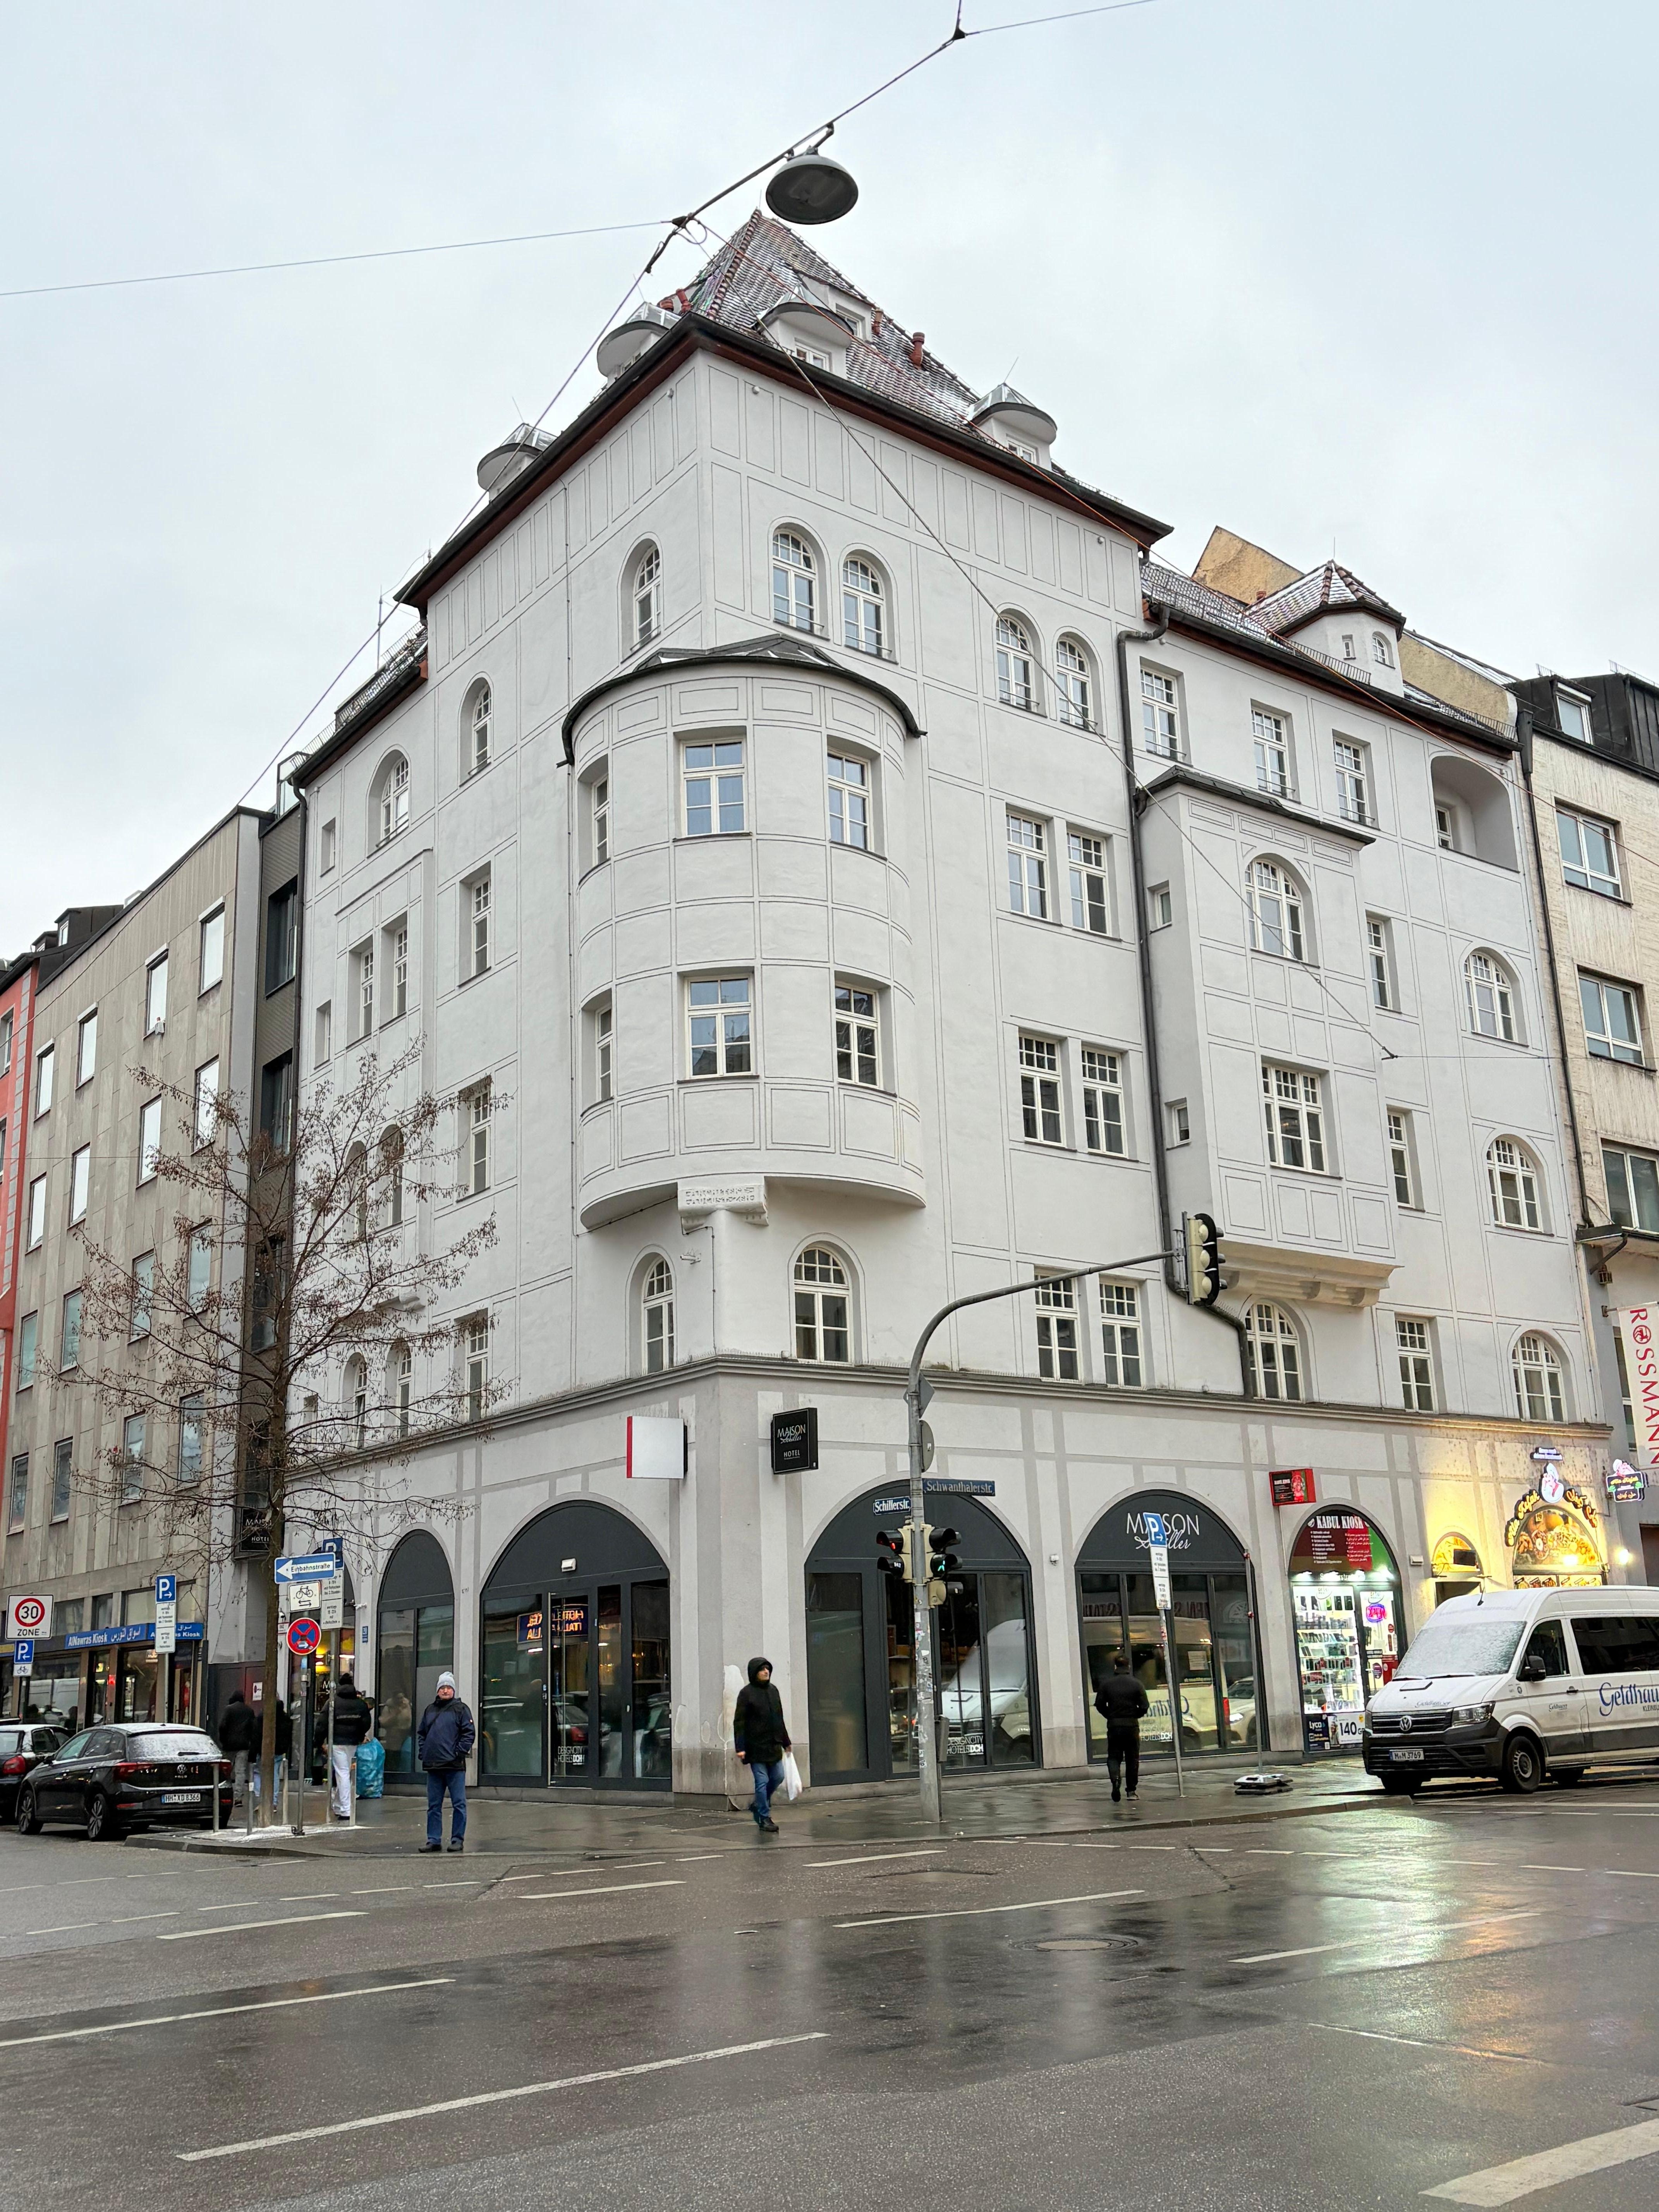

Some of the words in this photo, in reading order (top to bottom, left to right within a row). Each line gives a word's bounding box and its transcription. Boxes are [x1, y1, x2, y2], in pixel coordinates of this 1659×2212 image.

[1630, 1308, 1659, 1465] ROSSMANN
[777, 1424, 806, 1438] MAISON
[927, 1480, 993, 1493] Schwanthalerstr.
[874, 1499, 910, 1513] Schillerstr.
[1126, 1512, 1199, 1535] MSON
[1147, 1517, 1159, 1541] P
[1316, 1515, 1341, 1529] KABUL
[1341, 1516, 1364, 1529] KIOSK
[291, 1563, 330, 1572] Einbahnstraße
[159, 1578, 170, 1599] P
[21, 1606, 39, 1620] 30
[68, 1635, 92, 1647] AlNawras
[92, 1632, 108, 1644] Kiosk
[17, 1642, 29, 1661] P
[1309, 1721, 1322, 1730] Lyca
[1340, 1721, 1357, 1736] 140
[165, 1794, 173, 1802] HH
[185, 1793, 200, 1801] 8366
